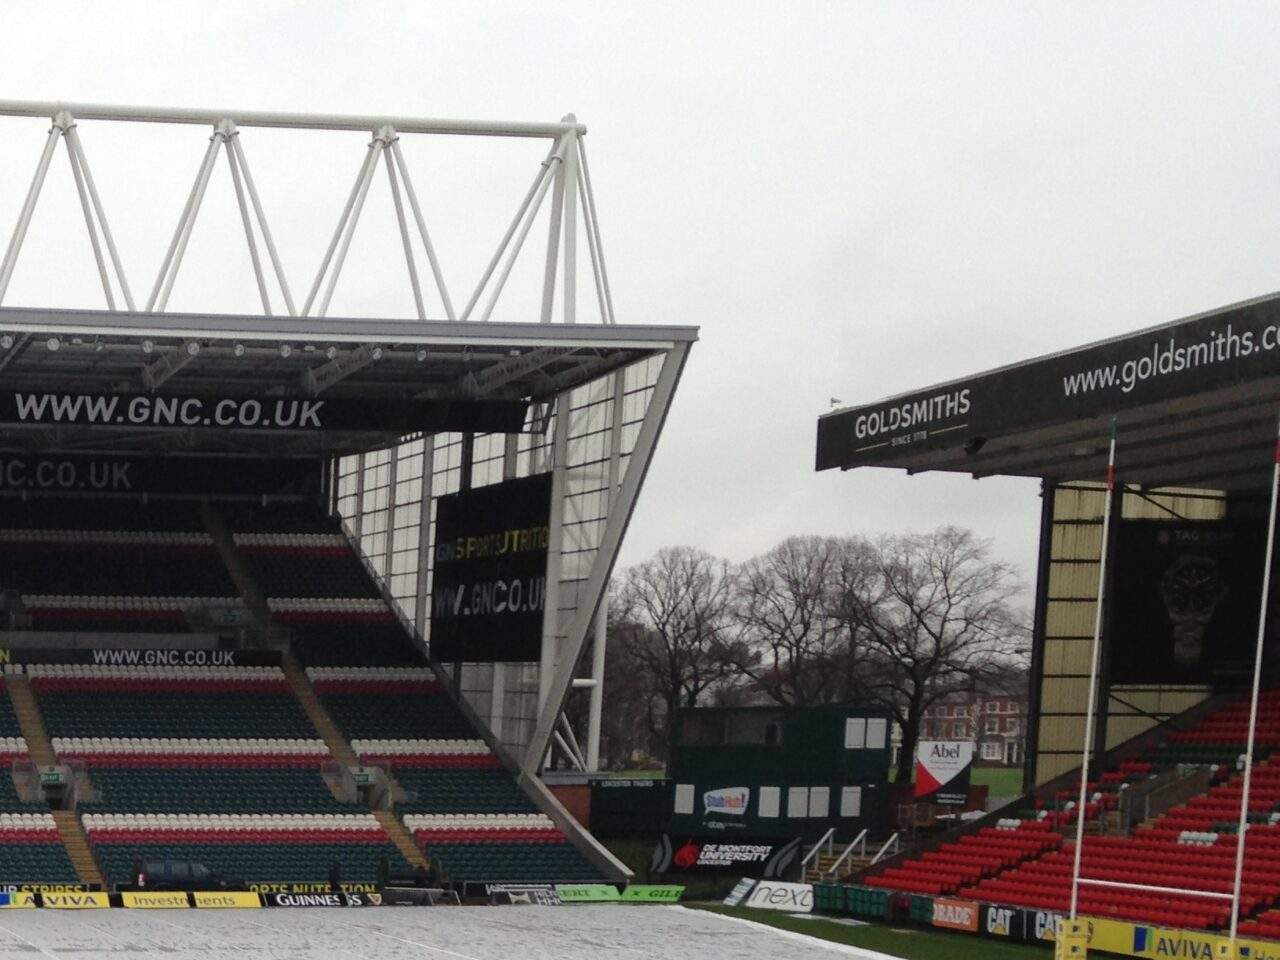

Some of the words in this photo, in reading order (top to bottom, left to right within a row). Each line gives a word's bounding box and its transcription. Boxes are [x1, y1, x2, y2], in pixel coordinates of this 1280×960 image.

[14, 392, 325, 428] WWW.GNC.CO.UK
[855, 389, 971, 439] GOLDSMITHS
[92, 649, 235, 665] WWW.GNC.CO.UK
[929, 744, 960, 758] Abel
[699, 851, 769, 861] UNIVERSITY
[703, 844, 718, 852] DE
[718, 845, 773, 853] MONTFORT
[24, 896, 97, 905] AVIVA
[987, 906, 1013, 936] CAT
[1157, 937, 1213, 960] AVIVA
